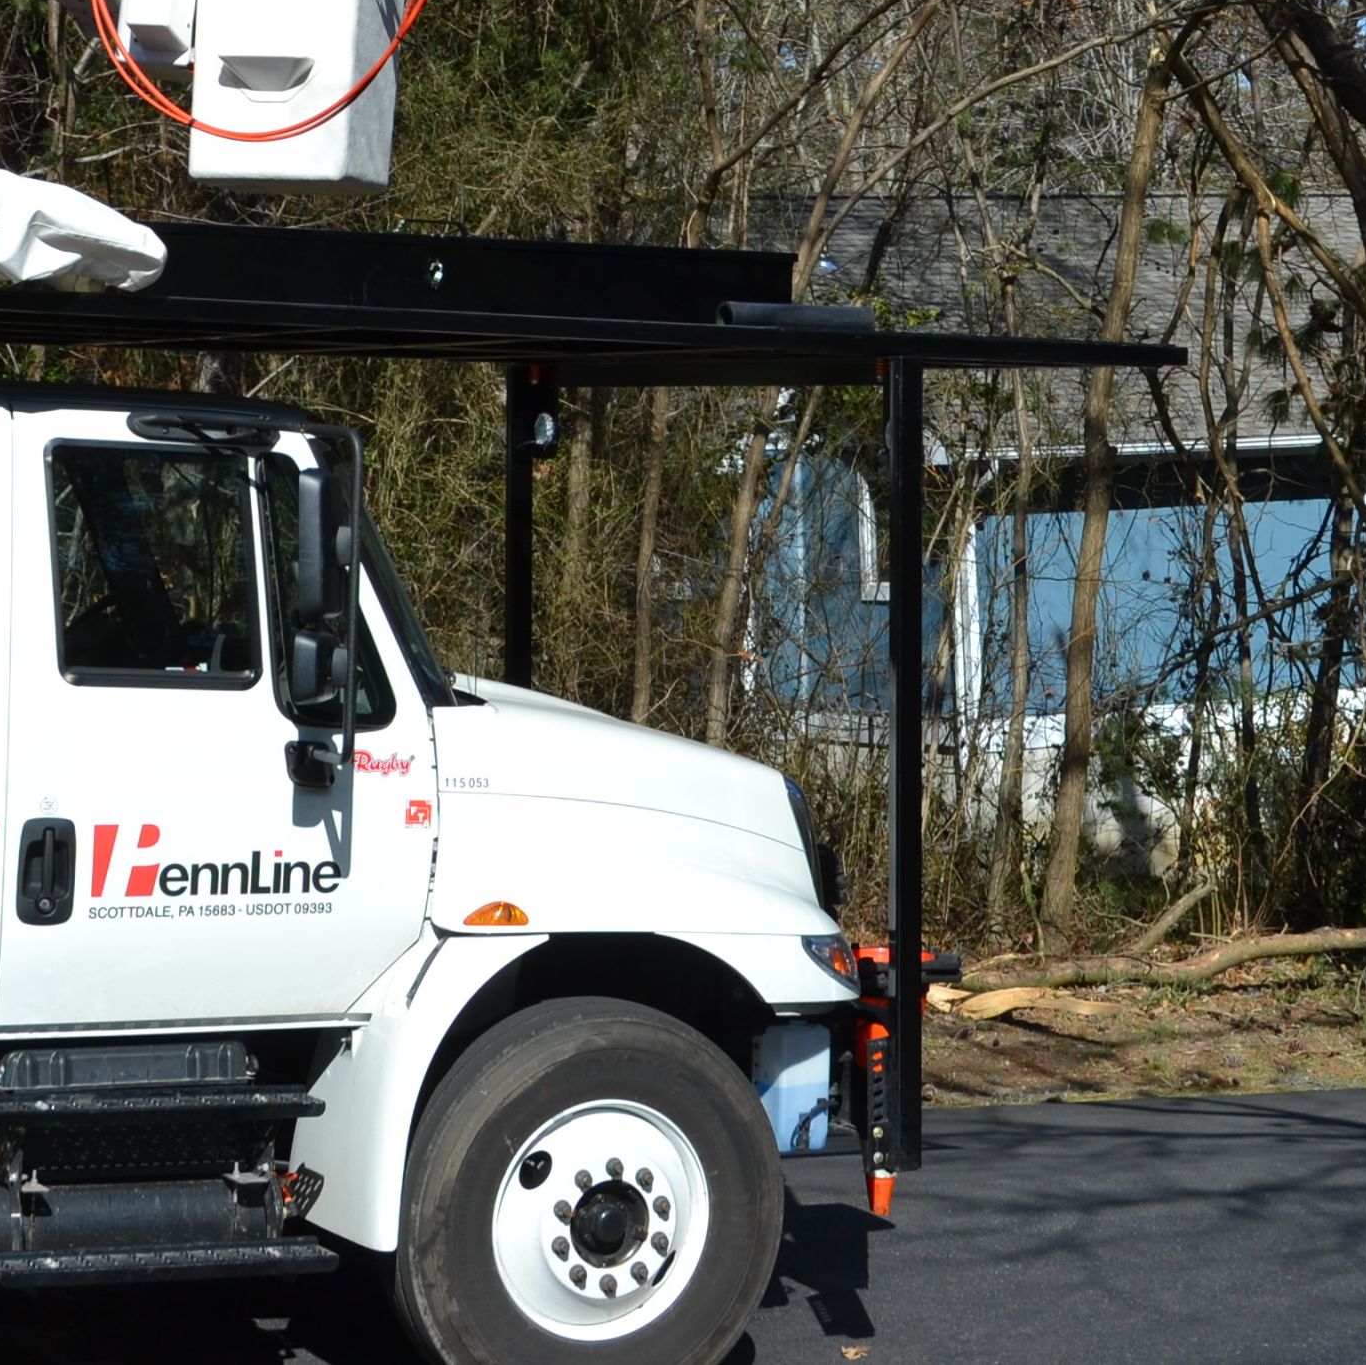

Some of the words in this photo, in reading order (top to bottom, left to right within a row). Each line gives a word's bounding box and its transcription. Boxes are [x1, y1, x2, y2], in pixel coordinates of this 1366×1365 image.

[351, 750, 411, 775] Rugby
[89, 905, 174, 919] SCOTTDALE,
[178, 905, 195, 917] PA
[198, 904, 236, 916] 15683
[246, 903, 292, 915] USDOT
[294, 902, 332, 914] 09393
